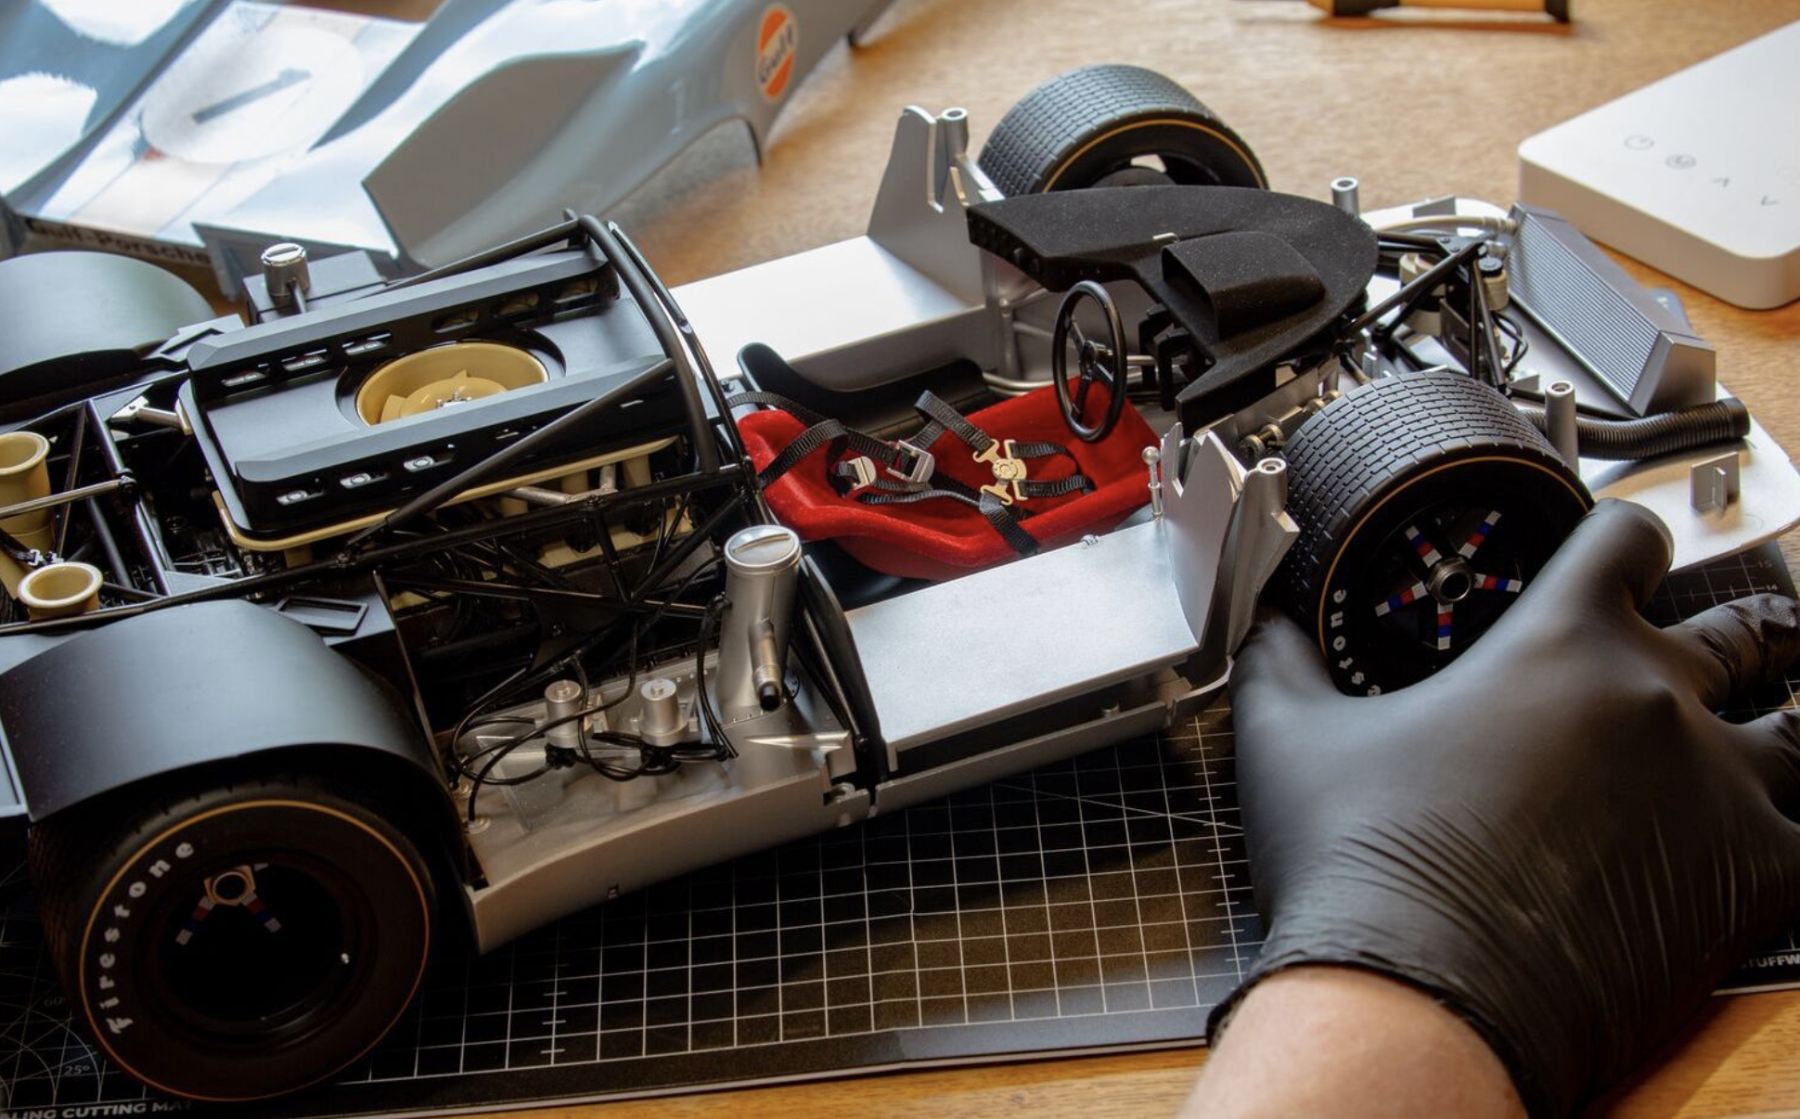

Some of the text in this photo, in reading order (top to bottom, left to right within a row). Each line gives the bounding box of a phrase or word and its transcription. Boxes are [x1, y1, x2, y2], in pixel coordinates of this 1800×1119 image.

[759, 23, 795, 84] Gulf
[99, 842, 194, 1034] Firestone
[62, 1102, 147, 1119] CUTTING
